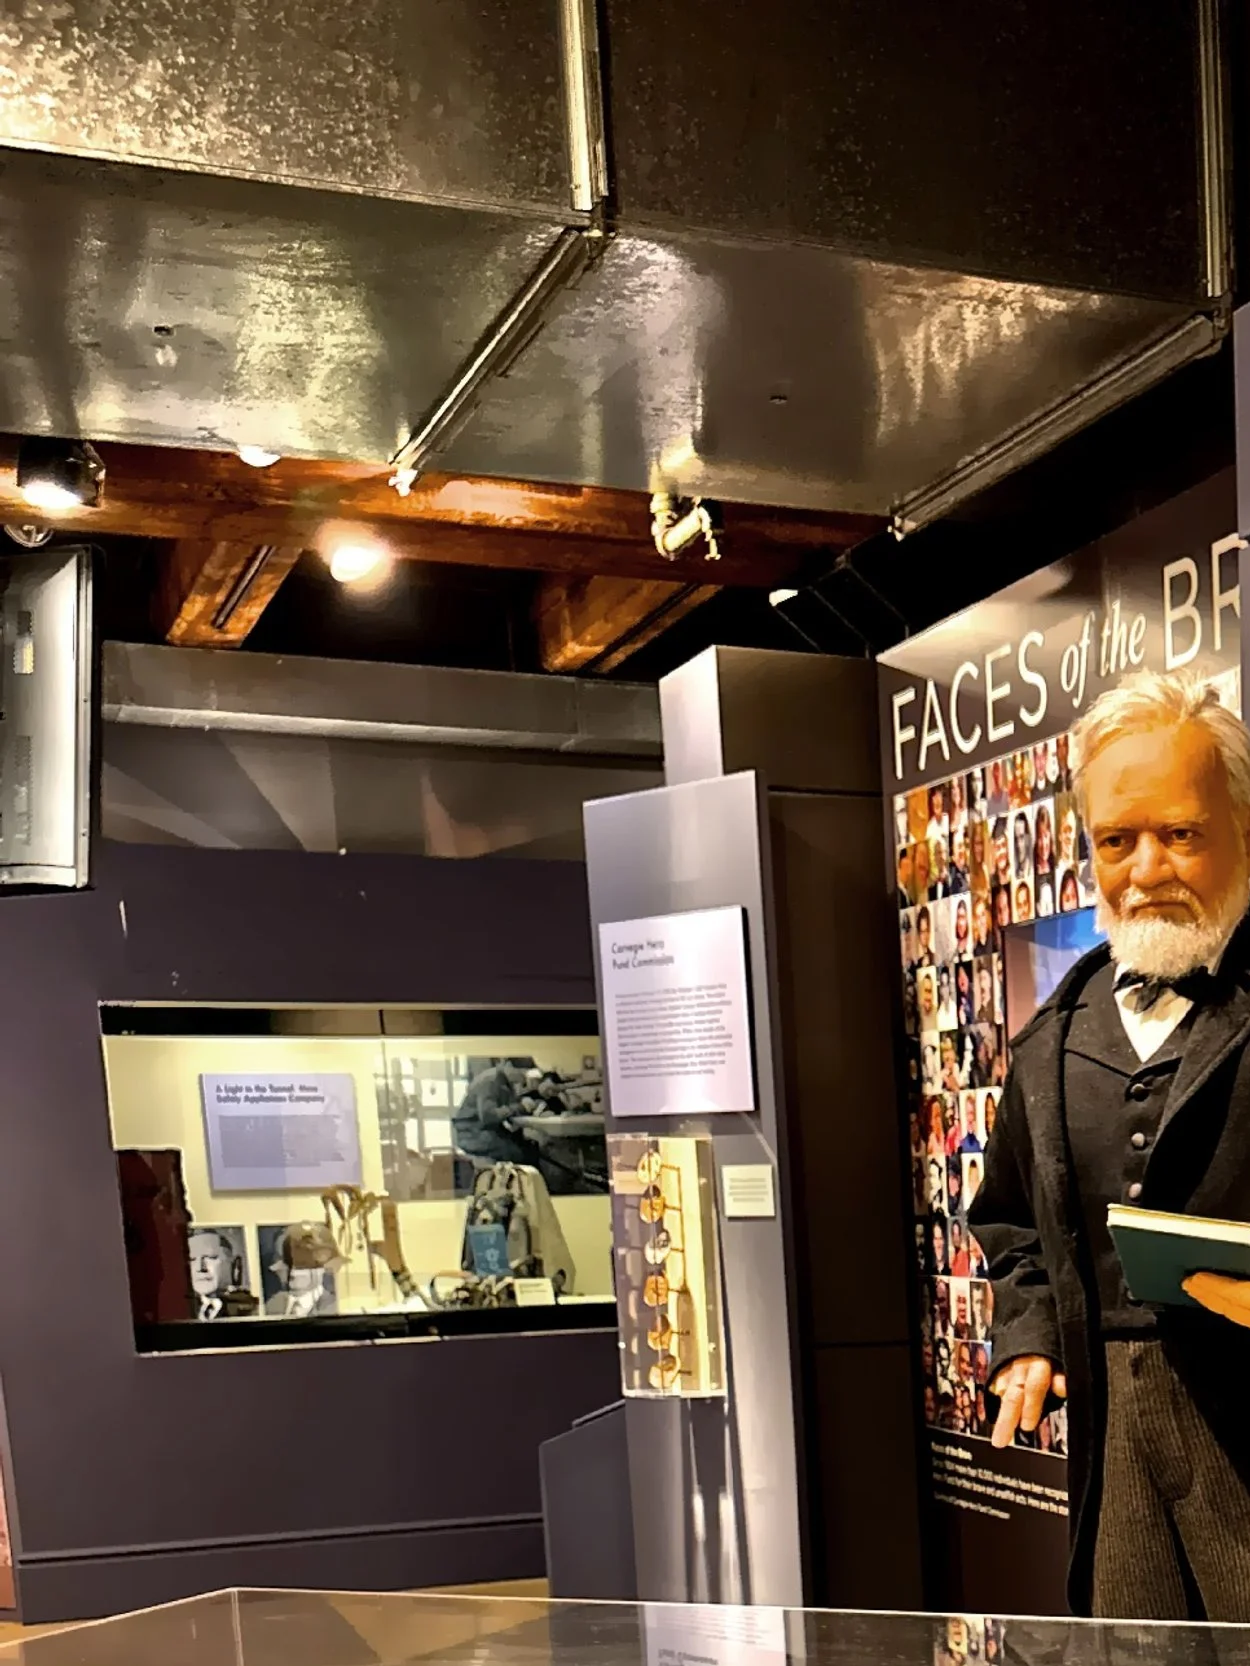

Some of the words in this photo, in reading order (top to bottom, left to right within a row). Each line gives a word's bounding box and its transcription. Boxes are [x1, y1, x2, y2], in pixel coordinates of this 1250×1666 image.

[892, 631, 1048, 780] FACES
[1061, 610, 1092, 708] of
[1100, 600, 1147, 677] the
